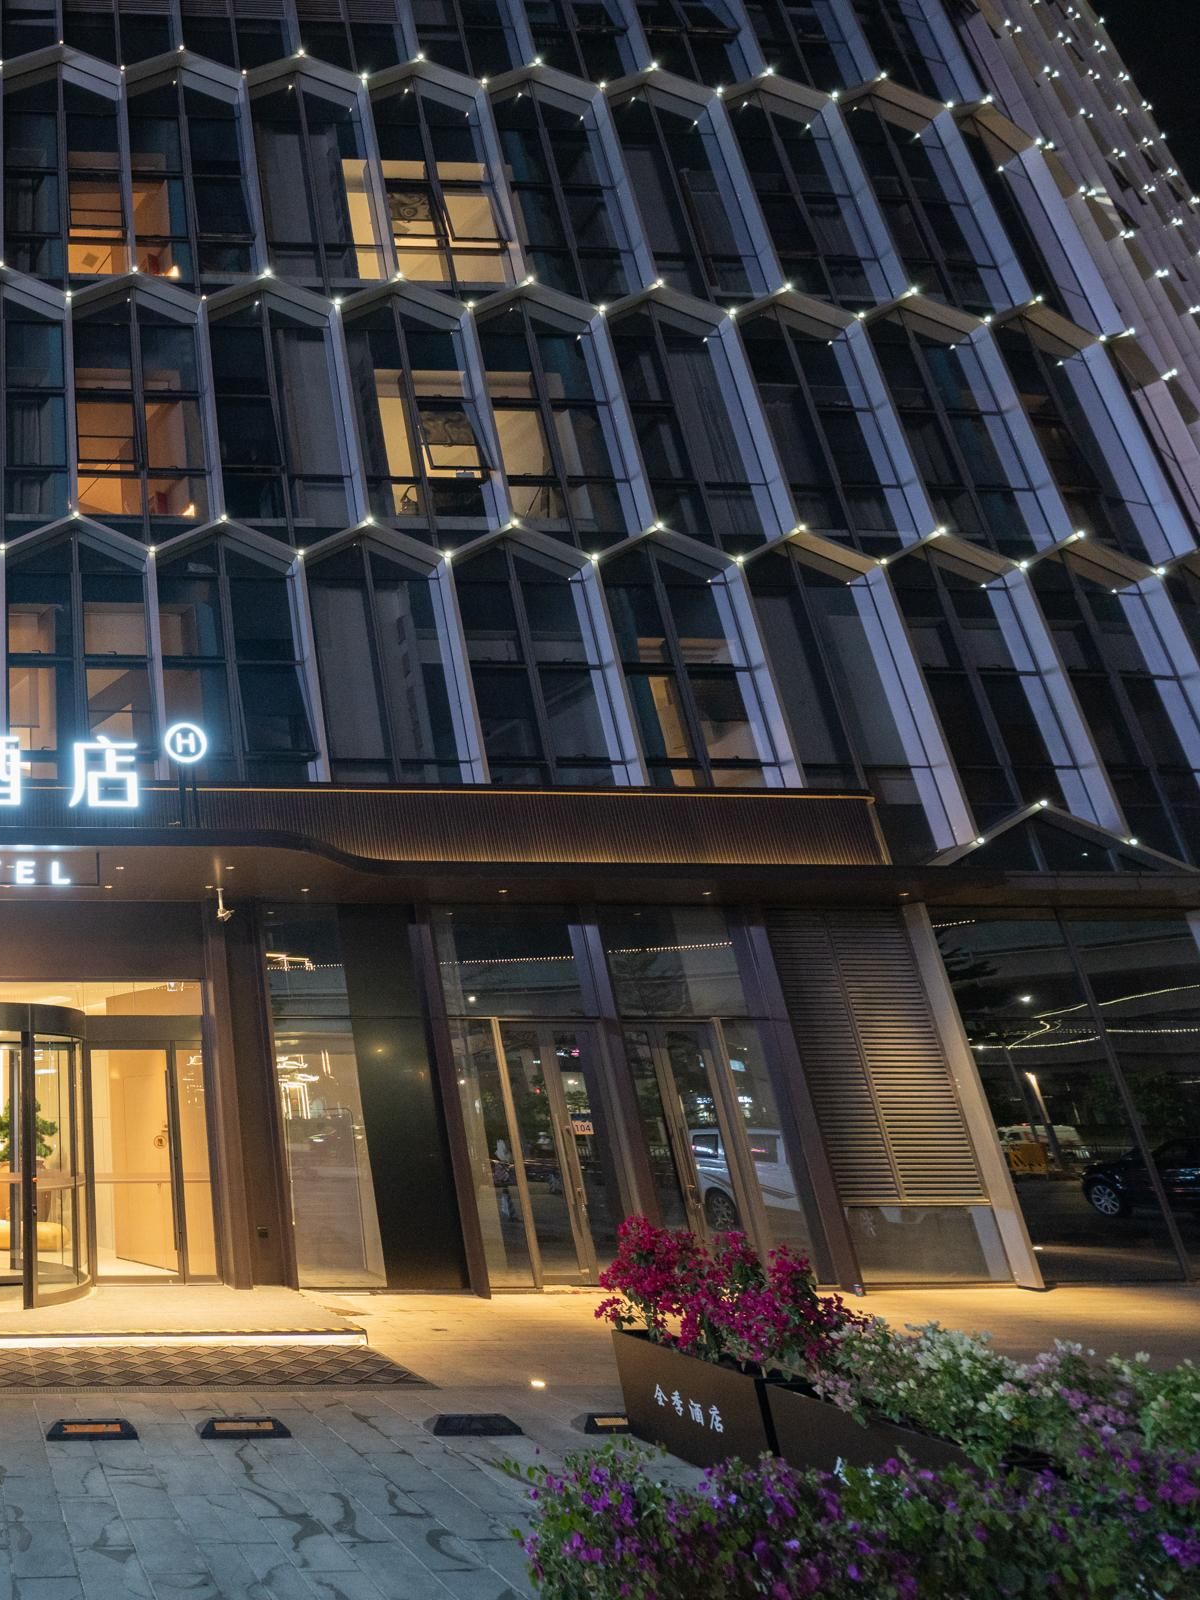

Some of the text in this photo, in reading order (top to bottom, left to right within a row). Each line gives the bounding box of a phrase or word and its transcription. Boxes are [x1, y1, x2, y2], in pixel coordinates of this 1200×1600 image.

[575, 1124, 591, 1132] 104
[654, 1384, 724, 1433] 全季酒店
